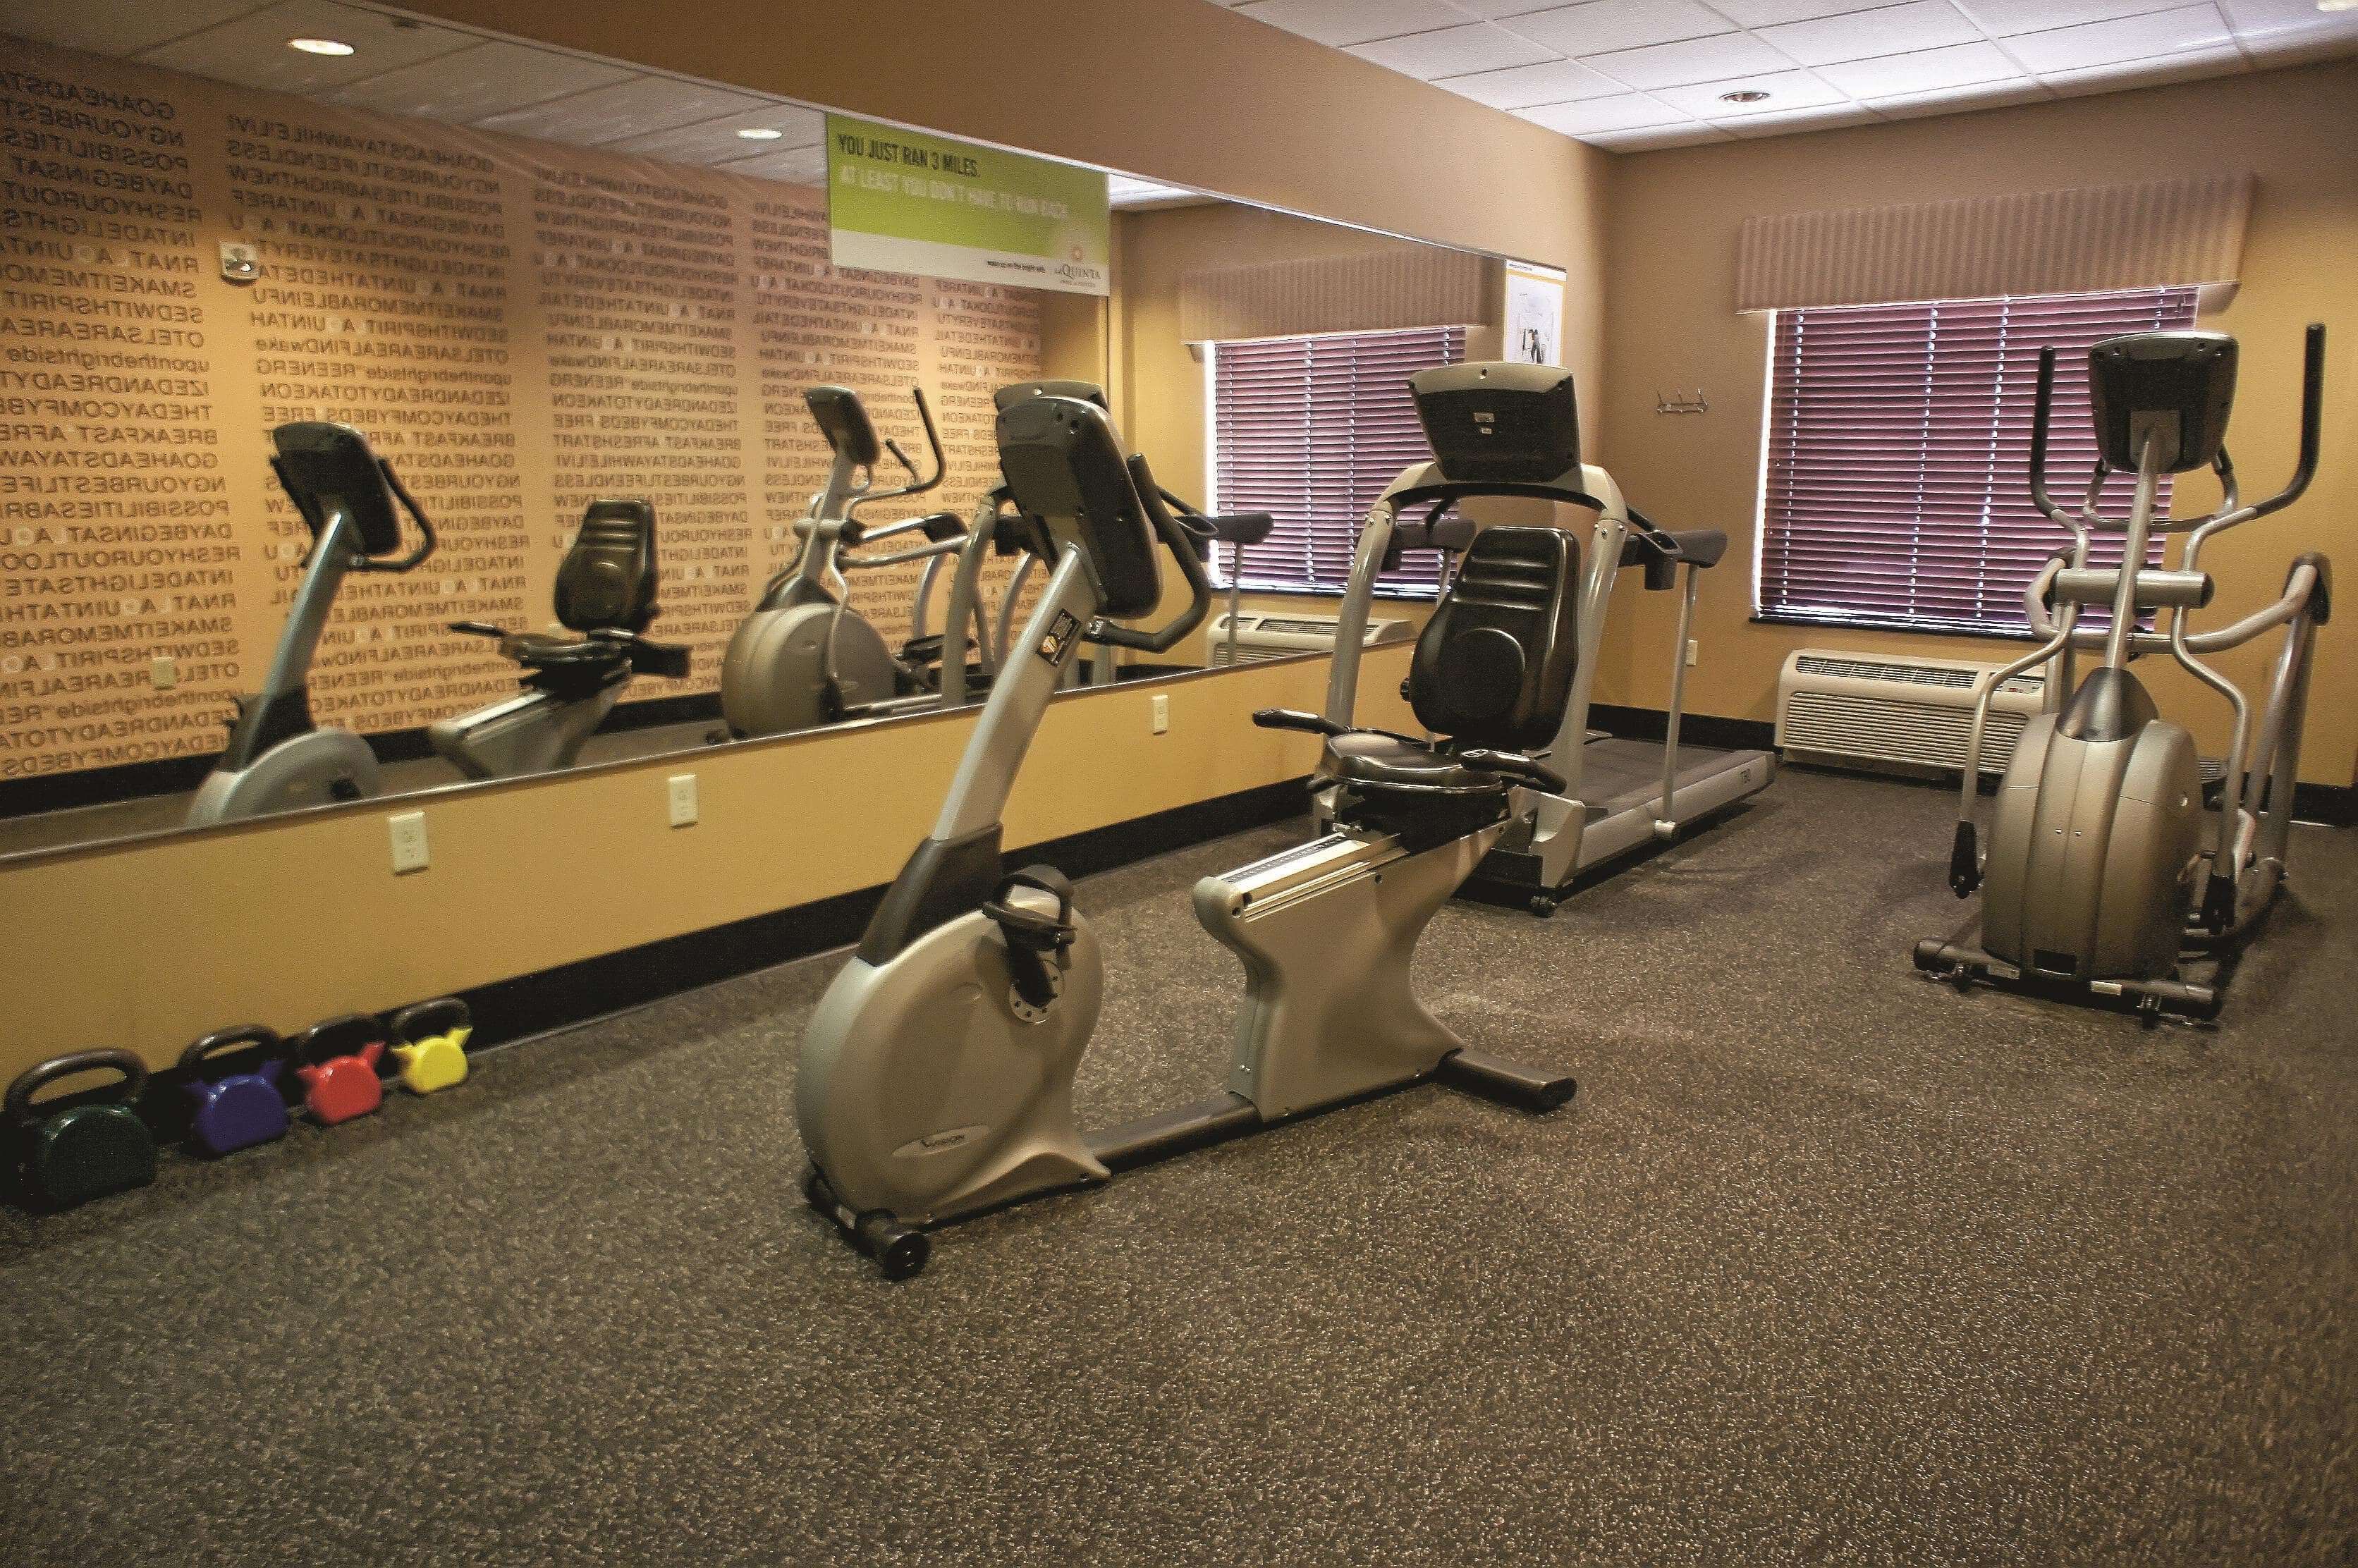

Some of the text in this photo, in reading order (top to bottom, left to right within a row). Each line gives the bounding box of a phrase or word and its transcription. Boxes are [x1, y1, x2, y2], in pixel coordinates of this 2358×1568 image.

[837, 133, 865, 156] YOU
[867, 139, 898, 162] JUST
[903, 146, 928, 168] RAN
[931, 152, 940, 170] 3
[859, 169, 898, 192] LEAST
[901, 176, 926, 197] YOU
[1062, 263, 1101, 280] QUINTA
